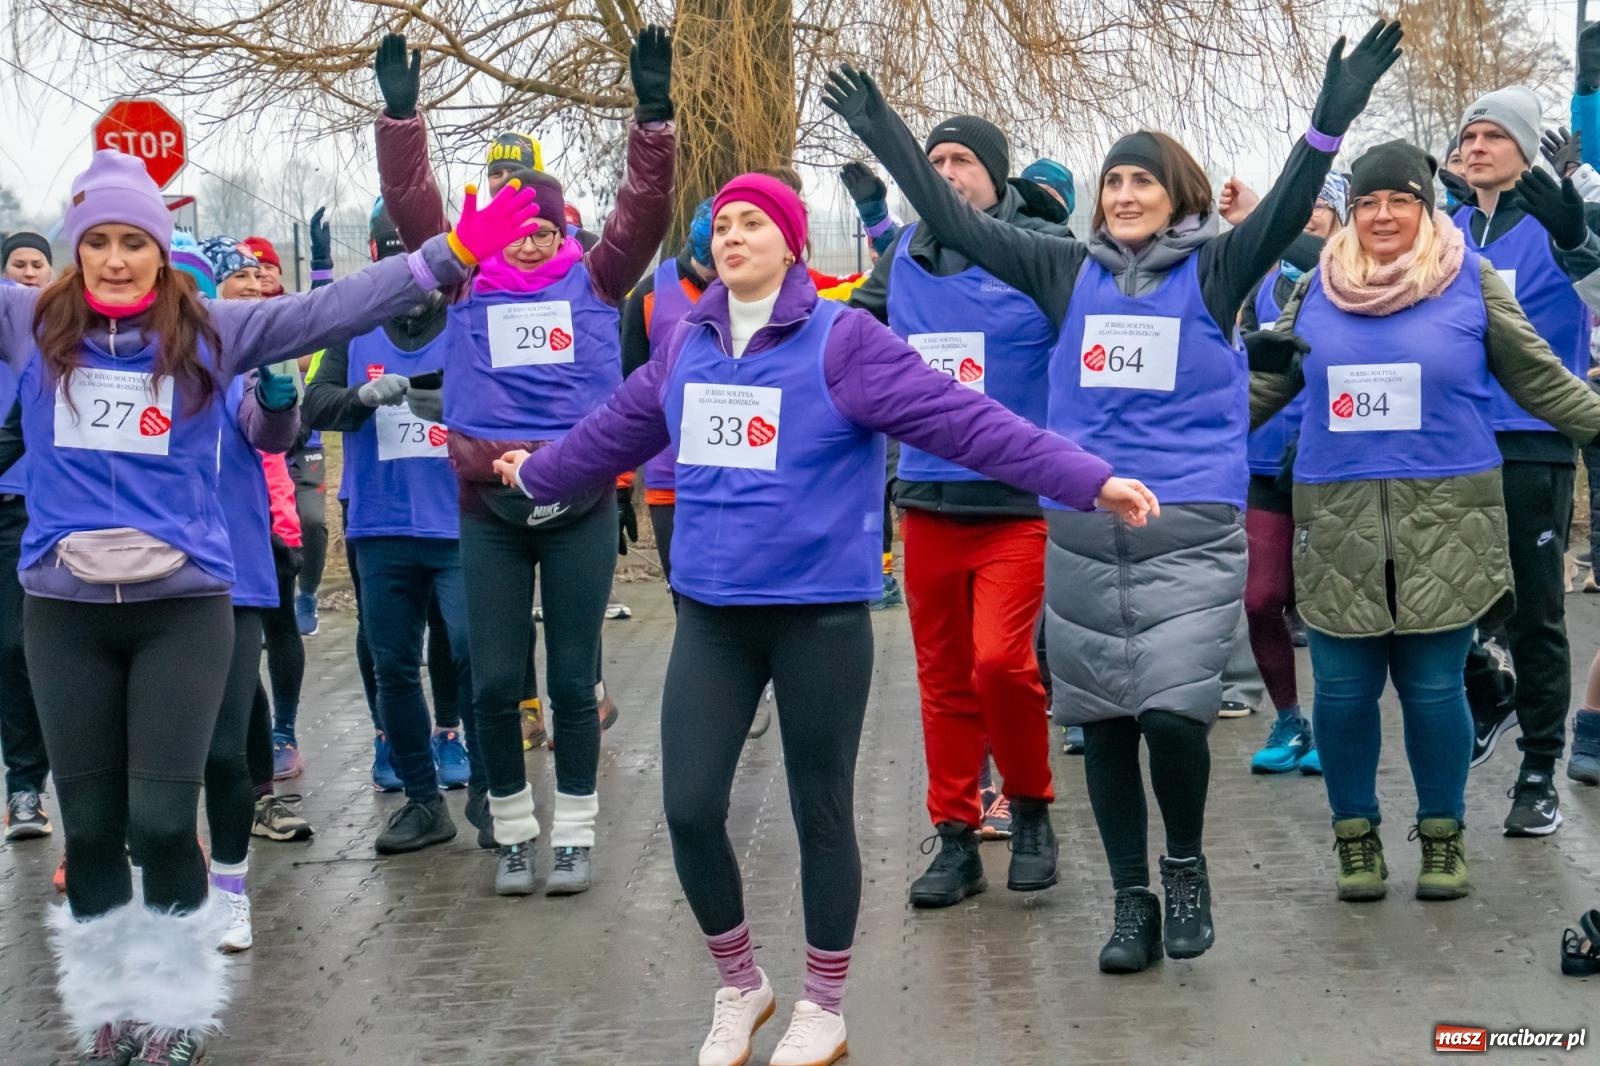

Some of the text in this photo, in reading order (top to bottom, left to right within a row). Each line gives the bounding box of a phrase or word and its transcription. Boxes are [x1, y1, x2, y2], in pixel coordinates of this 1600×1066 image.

[104, 131, 177, 158] STOP
[516, 326, 547, 349] 29
[1108, 345, 1144, 373] 64
[91, 399, 135, 429] 27
[1356, 392, 1390, 417] 84
[398, 422, 426, 443] 73
[707, 415, 743, 446] 33
[532, 501, 561, 518] NIKE
